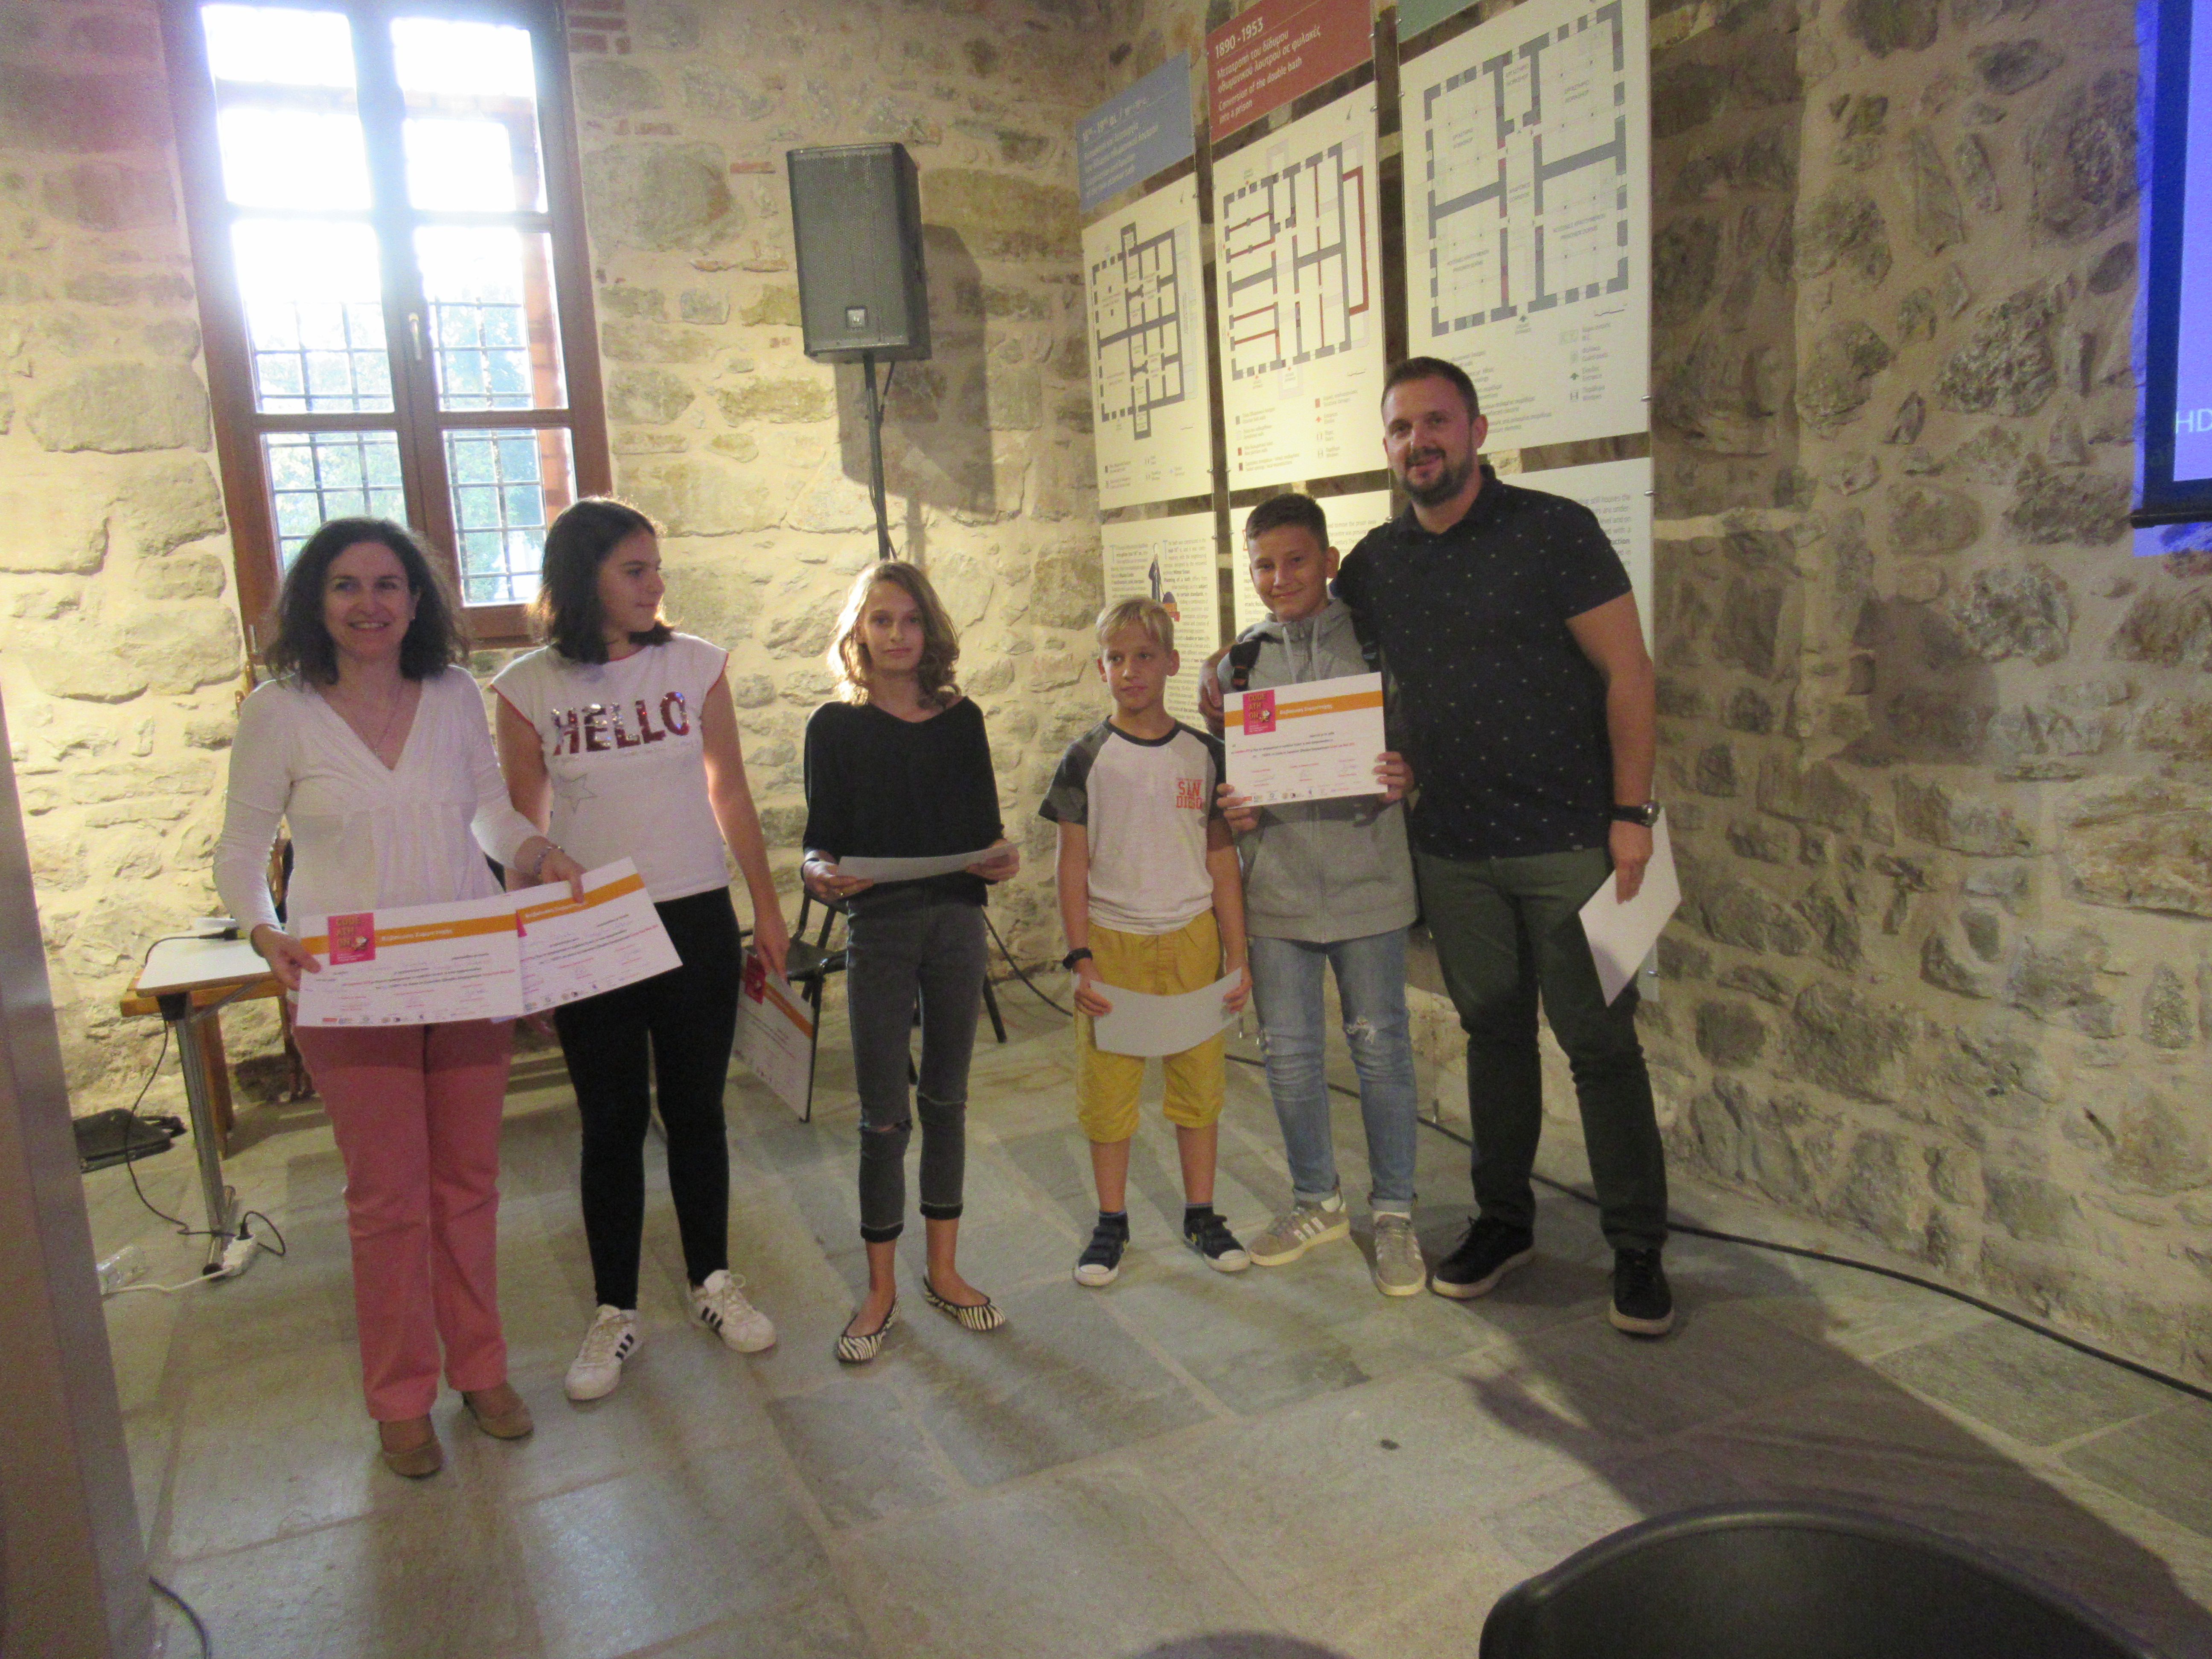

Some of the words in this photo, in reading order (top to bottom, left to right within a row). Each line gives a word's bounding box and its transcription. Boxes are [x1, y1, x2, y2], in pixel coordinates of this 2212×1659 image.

[1215, 35, 1236, 59] 1890
[1242, 16, 1263, 42] 1953
[1251, 47, 1261, 60] του
[1255, 48, 1281, 72] λουτρού
[1282, 44, 1290, 55] σε
[1292, 24, 1321, 52] φυλακές
[1219, 89, 1248, 111] Conversion
[1249, 81, 1255, 94] of
[1256, 78, 1266, 90] the
[1266, 66, 1287, 84] double
[1288, 56, 1302, 72] bath
[1231, 110, 1235, 118] a
[1235, 99, 1253, 119] prison
[551, 692, 690, 756] HELLO
